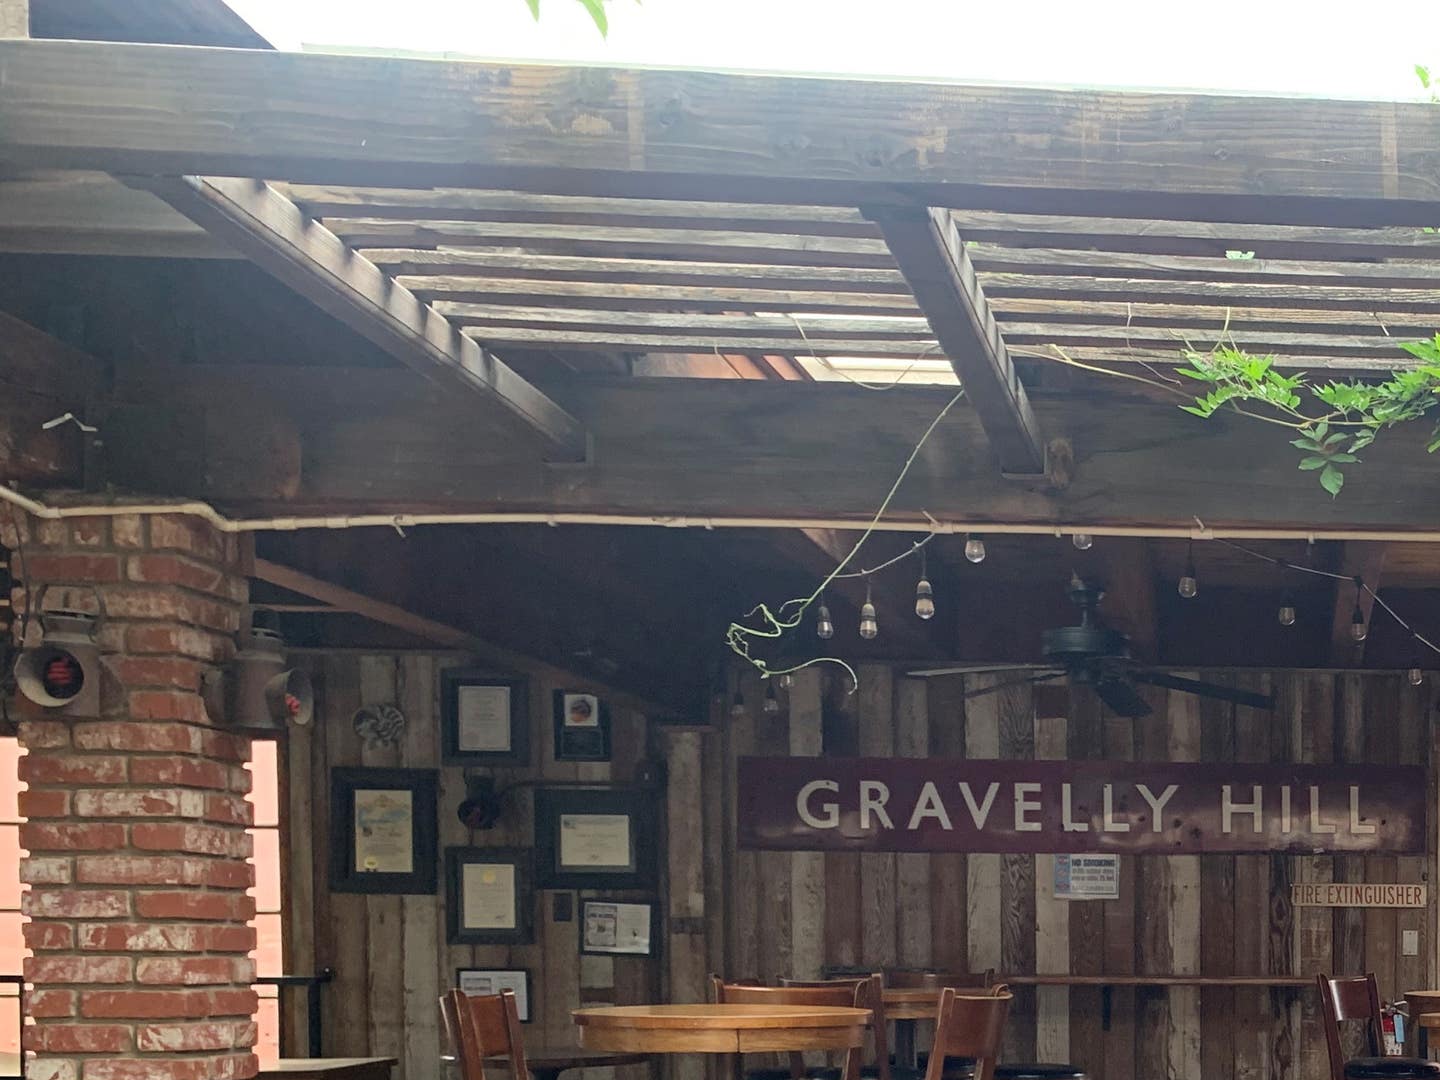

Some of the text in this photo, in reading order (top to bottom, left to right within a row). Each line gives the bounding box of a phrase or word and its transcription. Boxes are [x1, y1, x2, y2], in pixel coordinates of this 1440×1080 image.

[797, 780, 1376, 834] GRAVELLY HILL
[1294, 885, 1422, 905] FIRE EXTINGUISHER
